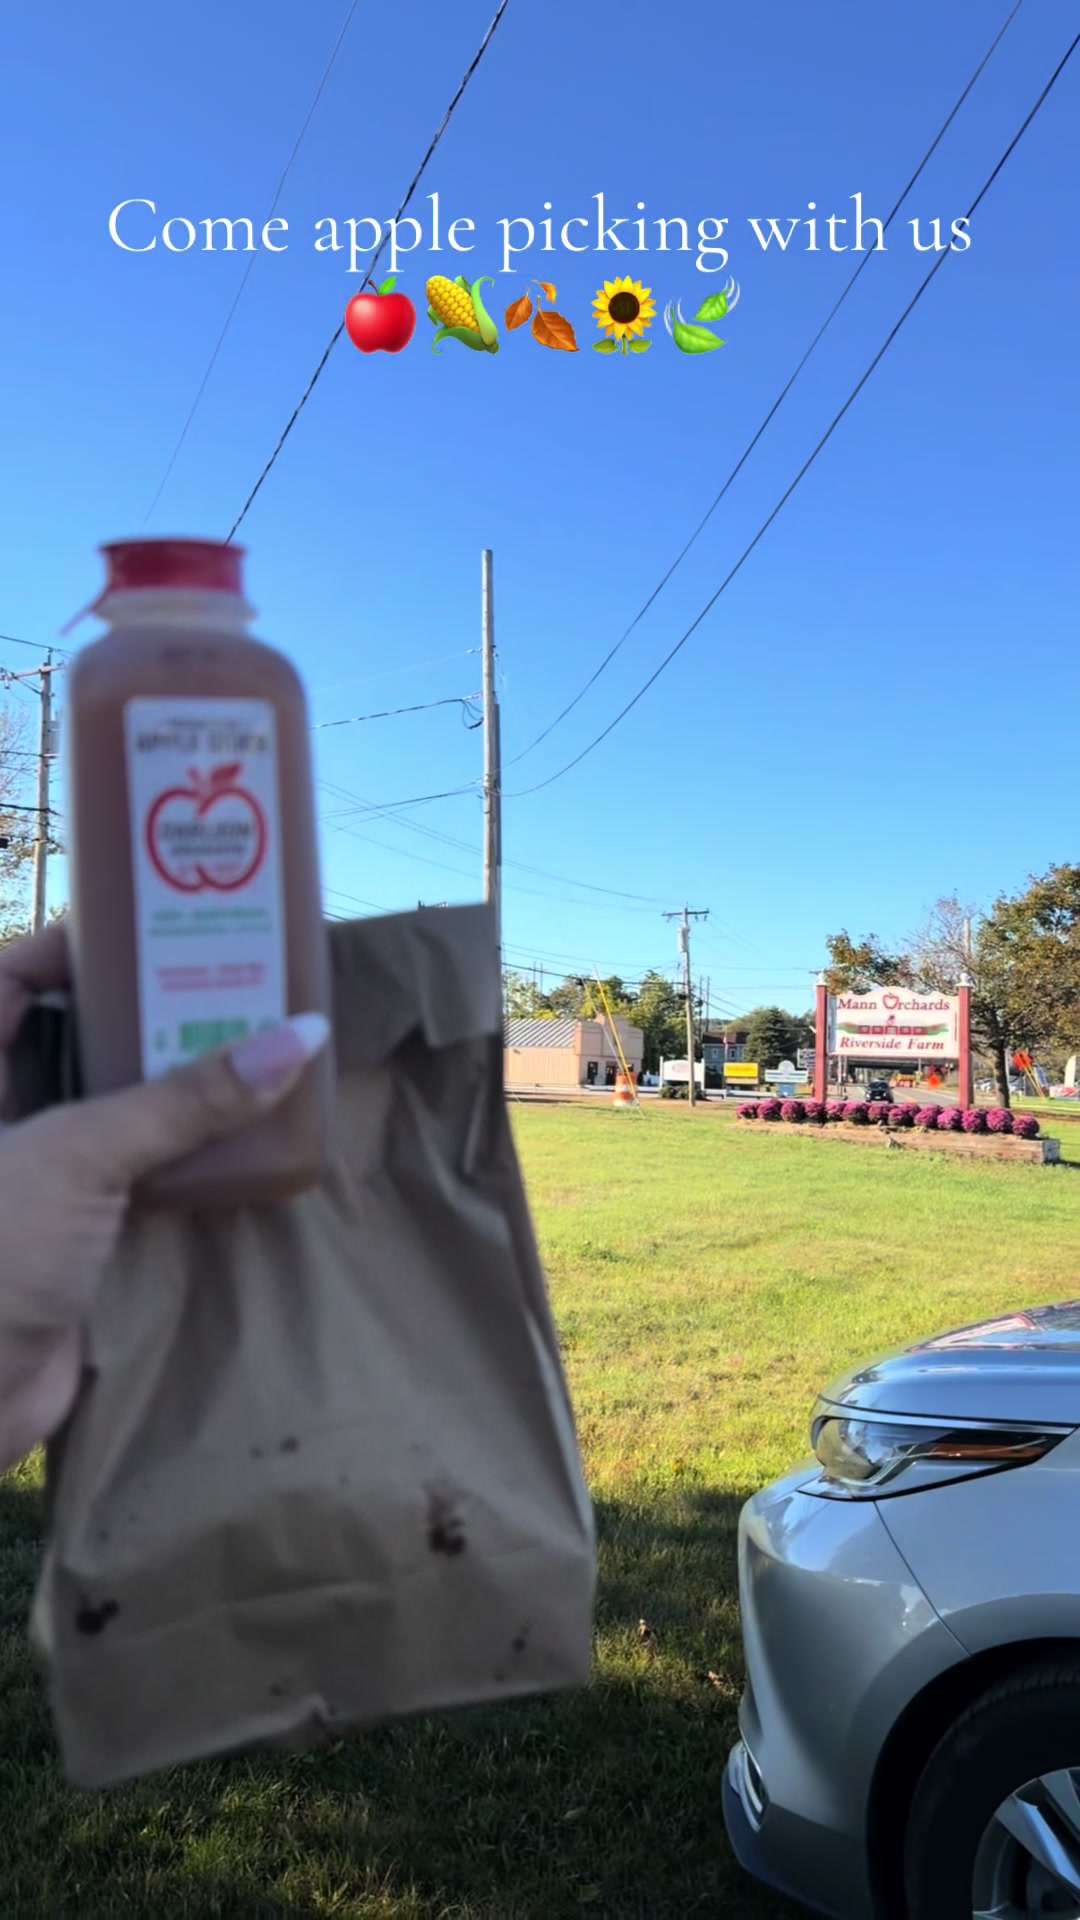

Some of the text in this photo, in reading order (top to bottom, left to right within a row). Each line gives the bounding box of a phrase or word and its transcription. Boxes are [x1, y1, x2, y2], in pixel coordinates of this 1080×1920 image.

[838, 993, 950, 1011] Mann Orchards
[840, 1036, 944, 1051] Riverside Farm
